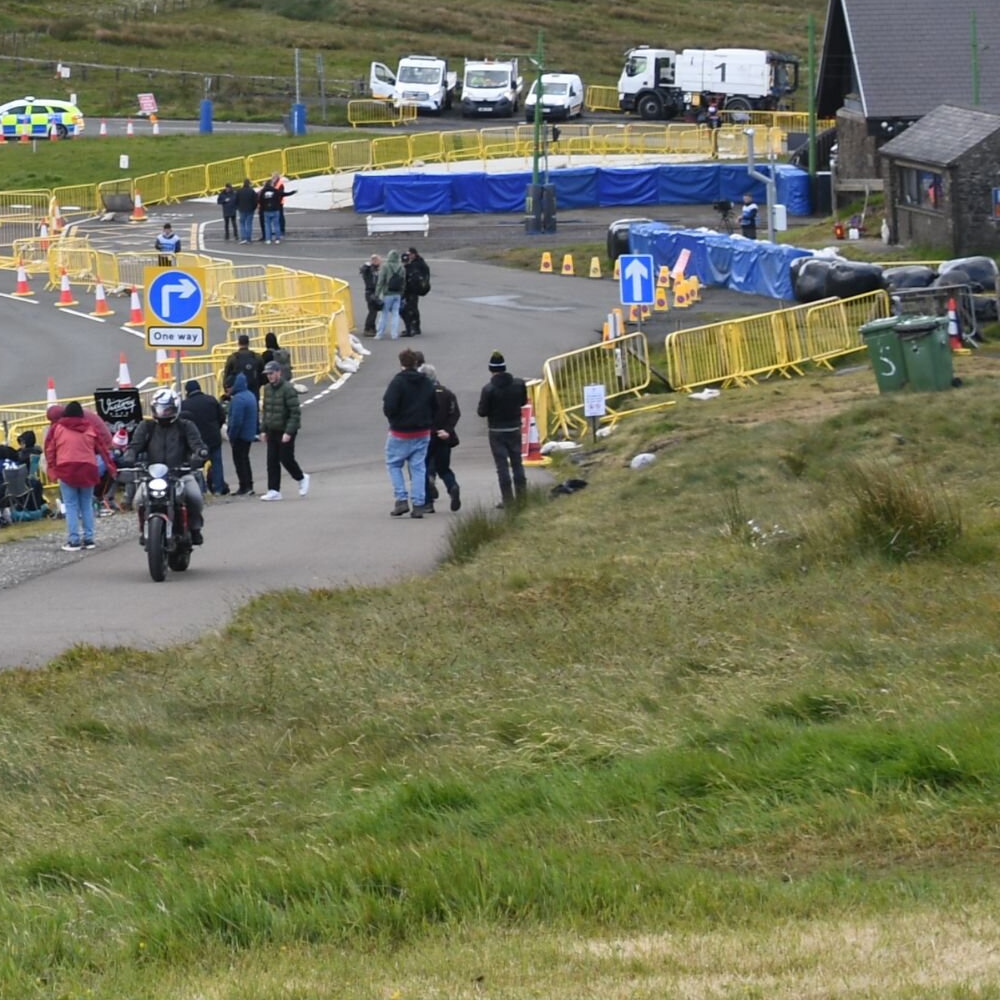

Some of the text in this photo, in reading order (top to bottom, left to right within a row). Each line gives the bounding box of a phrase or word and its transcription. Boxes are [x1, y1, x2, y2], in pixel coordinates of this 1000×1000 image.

[714, 62, 727, 82] 1
[153, 331, 199, 343] One way
